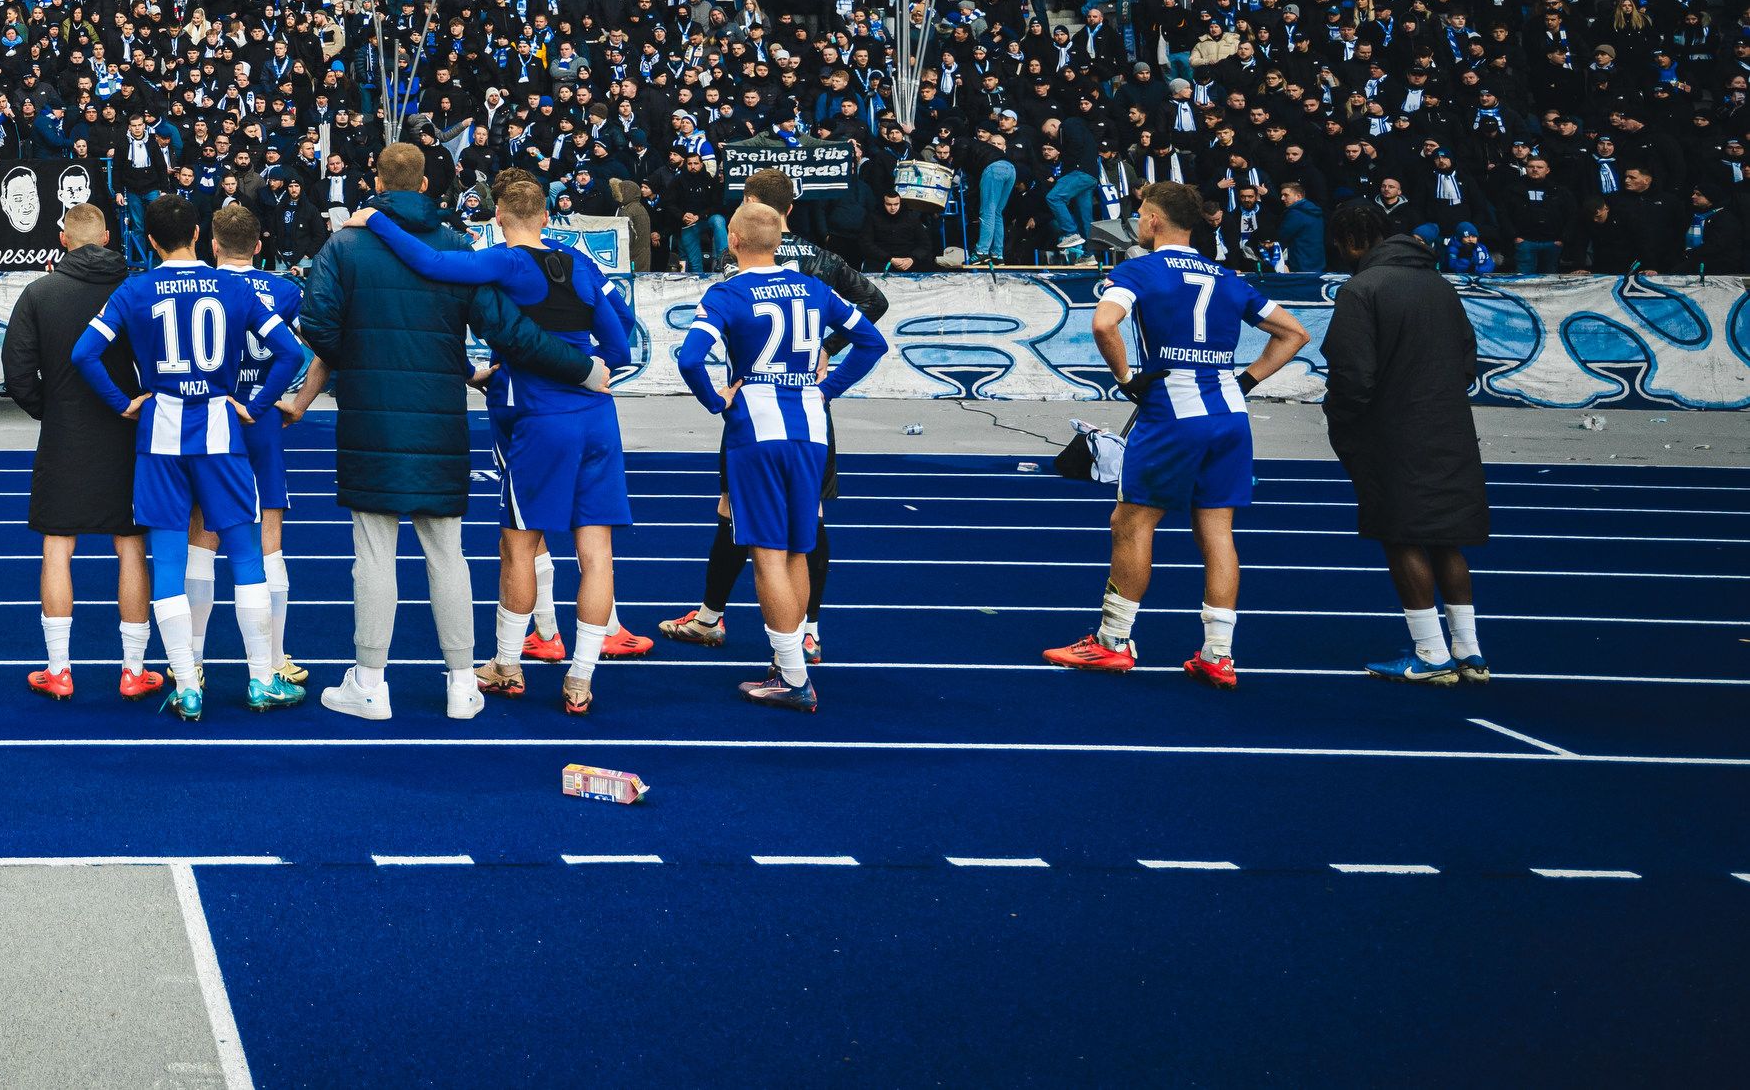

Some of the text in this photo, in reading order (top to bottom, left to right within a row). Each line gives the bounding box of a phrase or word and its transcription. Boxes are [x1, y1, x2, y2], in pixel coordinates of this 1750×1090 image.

[726, 148, 849, 162] Freiheit für
[775, 245, 816, 257] RTHA BSC
[1164, 257, 1224, 277] HERTHA BSC
[155, 279, 219, 294] HERTHA BSC
[252, 279, 270, 291] BSC
[750, 283, 810, 301] HERTHA BSC
[1183, 272, 1216, 343] 7
[152, 296, 227, 372] 10
[752, 299, 821, 374] 24
[1159, 346, 1234, 364] NIEDERLECHNER
[238, 369, 259, 382] NNY
[179, 380, 209, 396] MAZA
